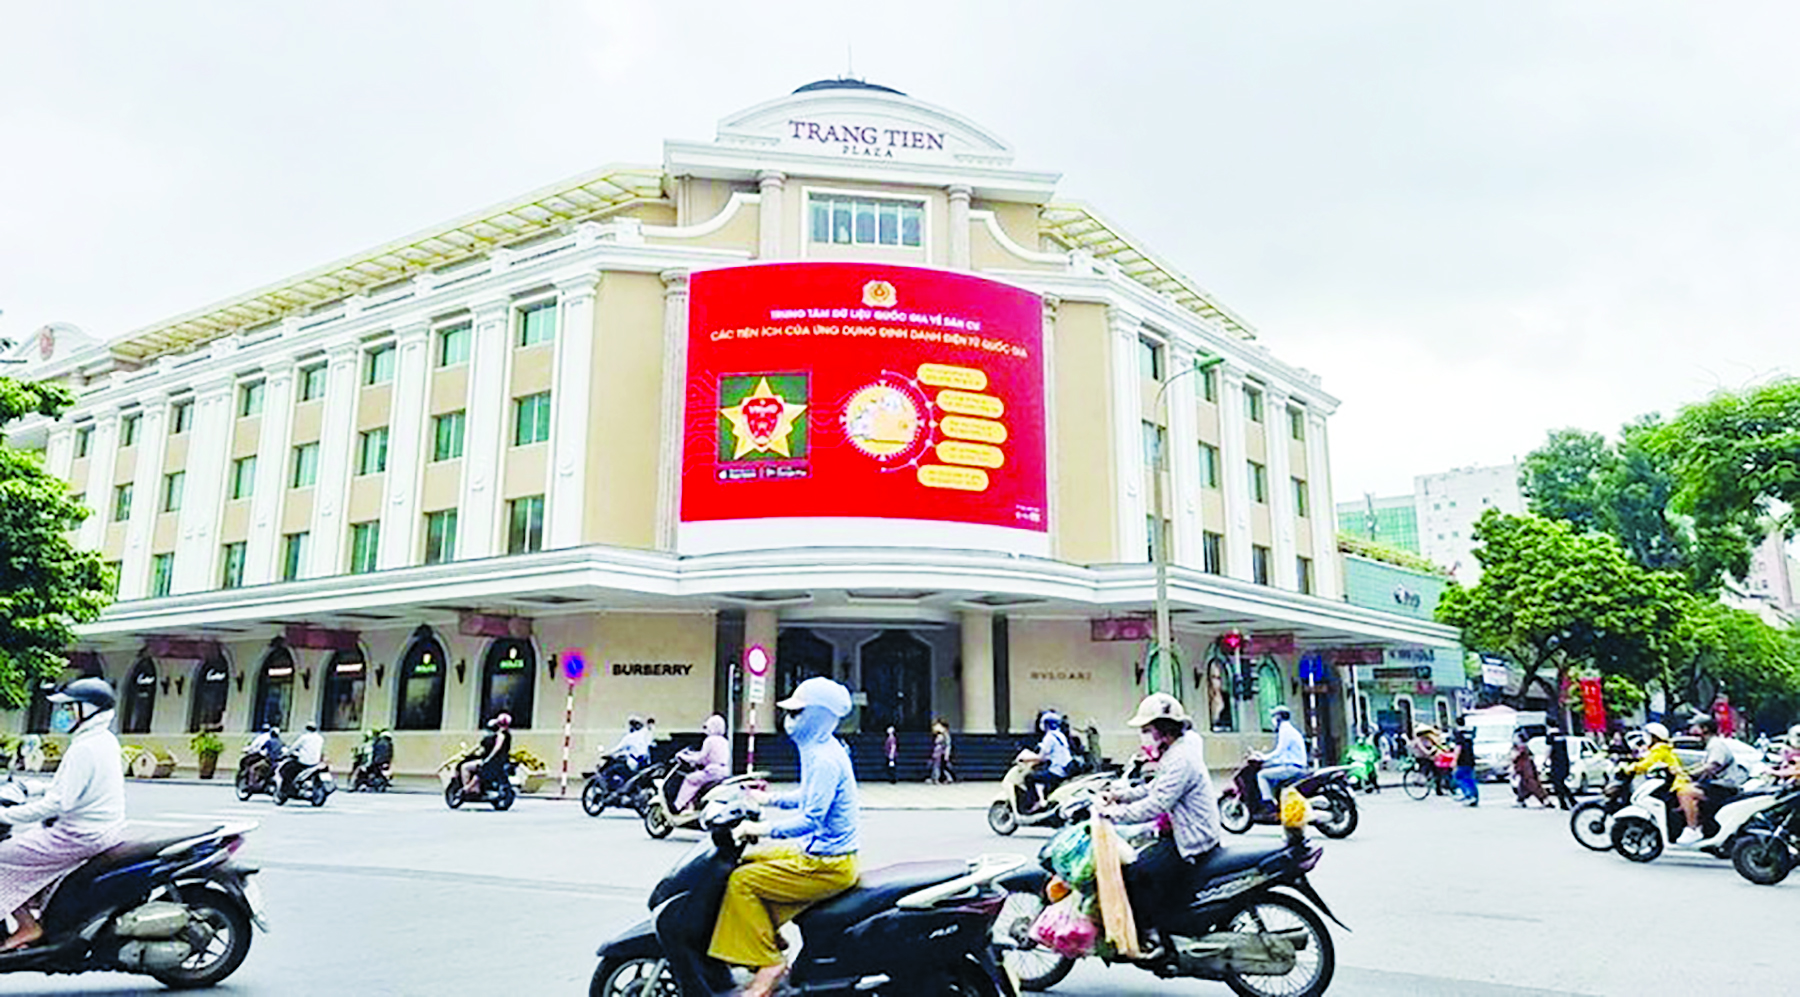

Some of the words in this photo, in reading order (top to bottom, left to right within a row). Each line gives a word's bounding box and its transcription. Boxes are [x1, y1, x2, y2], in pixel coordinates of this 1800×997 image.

[789, 120, 877, 145] TRANG
[884, 129, 945, 150] TIEN
[842, 146, 893, 158] PLAZA
[710, 328, 734, 341] CÁC
[784, 324, 810, 336] CỦA
[612, 663, 693, 676] BURBERRY
